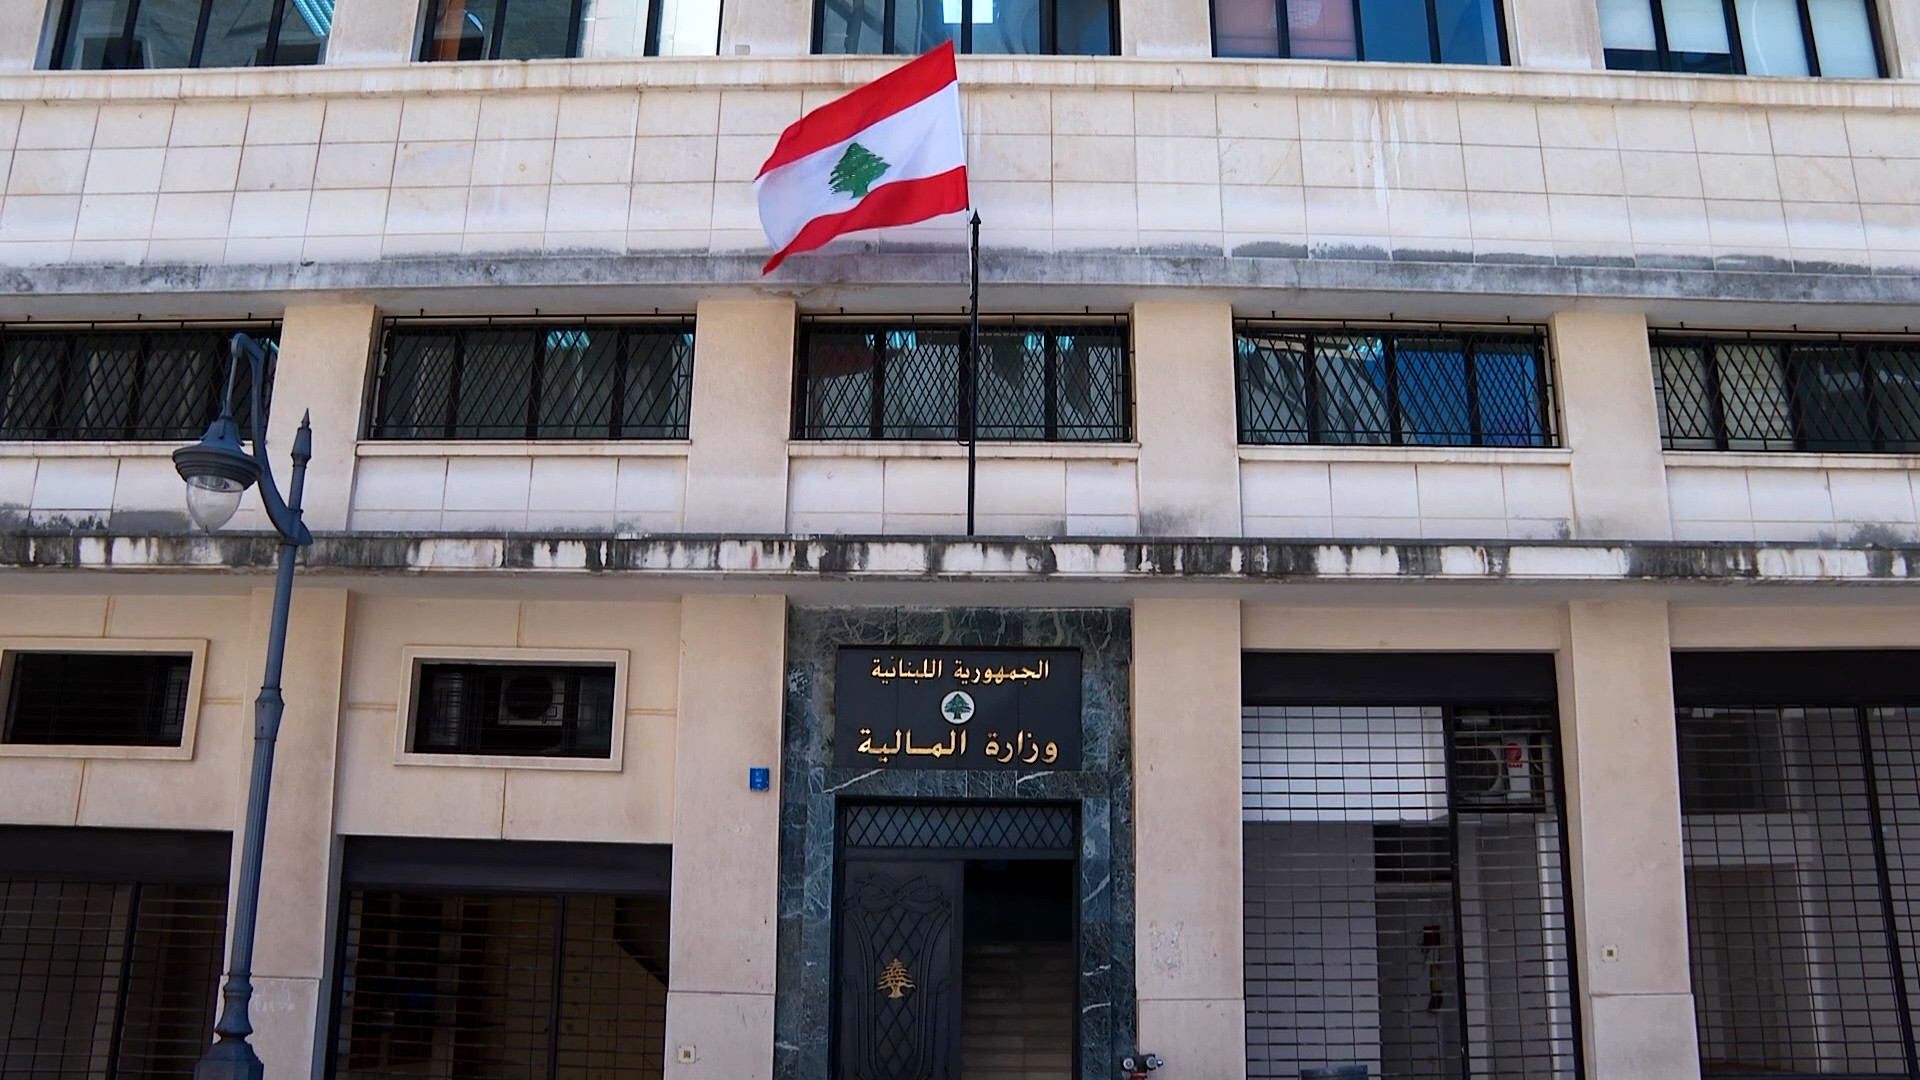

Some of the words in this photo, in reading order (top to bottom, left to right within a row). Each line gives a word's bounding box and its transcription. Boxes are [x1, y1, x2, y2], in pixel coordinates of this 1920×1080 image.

[871, 656, 943, 685] اللبنانية
[953, 658, 1049, 685] الجمهورية
[857, 727, 967, 764] المالية
[985, 729, 1059, 764] وزارة
